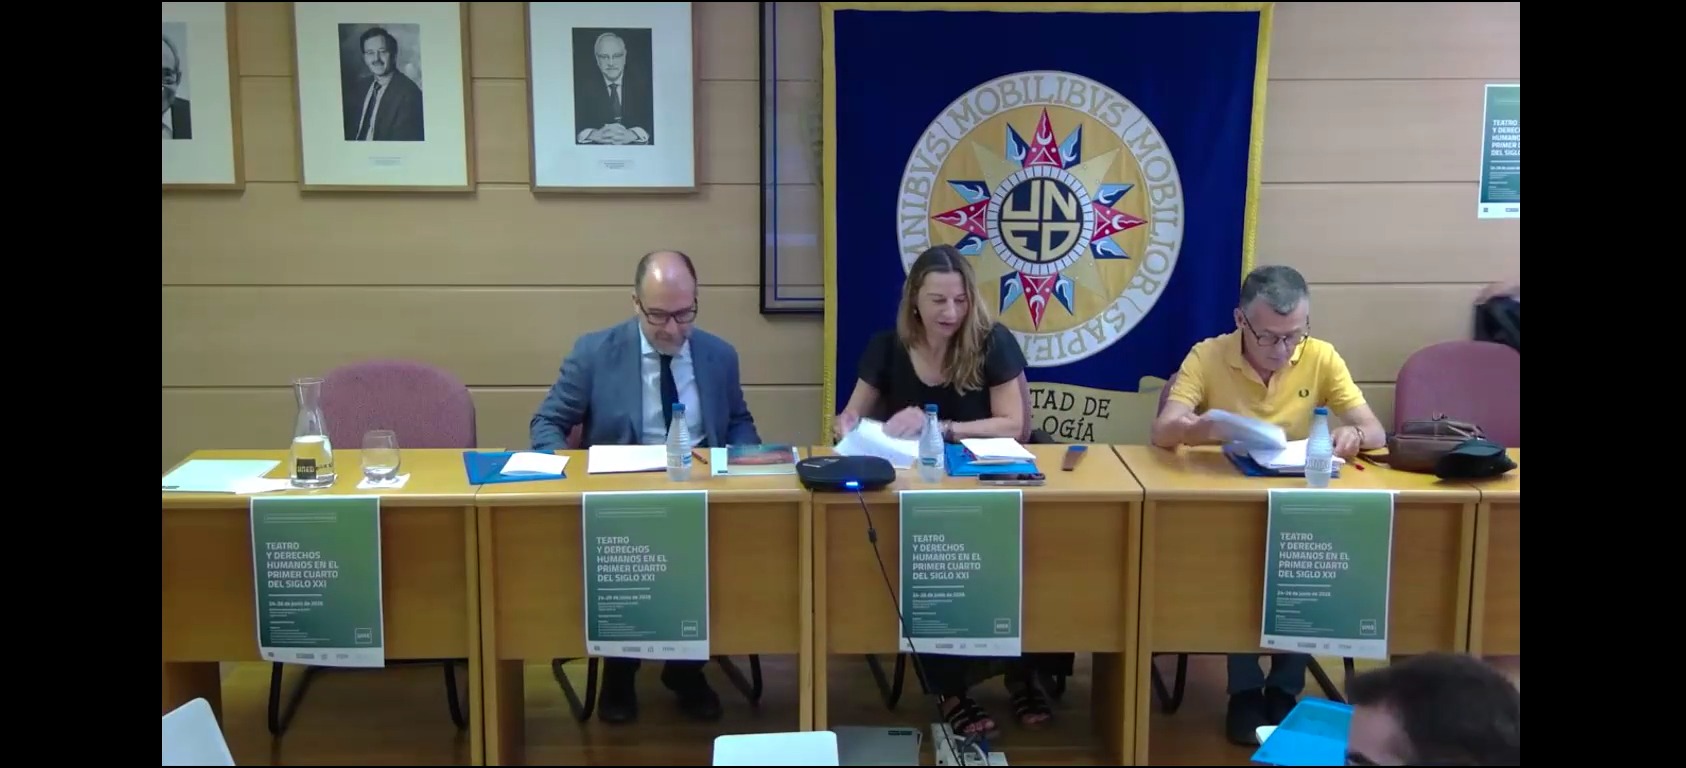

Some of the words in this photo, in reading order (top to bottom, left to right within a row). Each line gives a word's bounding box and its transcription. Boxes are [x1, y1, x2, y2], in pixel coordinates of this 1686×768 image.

[947, 76, 1130, 134] MOBILIBVS
[1127, 126, 1178, 295] MOBILIOR
[1030, 388, 1075, 412] TAD
[1083, 396, 1111, 418] DE
[1042, 416, 1095, 442] OGÍA
[1280, 532, 1313, 540] TEATRO
[604, 546, 650, 554] DERECHOS
[920, 544, 964, 552] DERECHOS
[1288, 542, 1332, 550] DERECHOS
[597, 555, 642, 563] HUMANOS
[1279, 552, 1324, 560] HUMANOS
[597, 564, 630, 573] PRIMER
[632, 564, 667, 572] CUARTO
[947, 562, 981, 570] CUARTO
[1279, 561, 1312, 569] PRIMER
[1314, 561, 1348, 570] CUARTO
[615, 574, 639, 582] SIGLO
[1296, 570, 1320, 578] SIGLO
